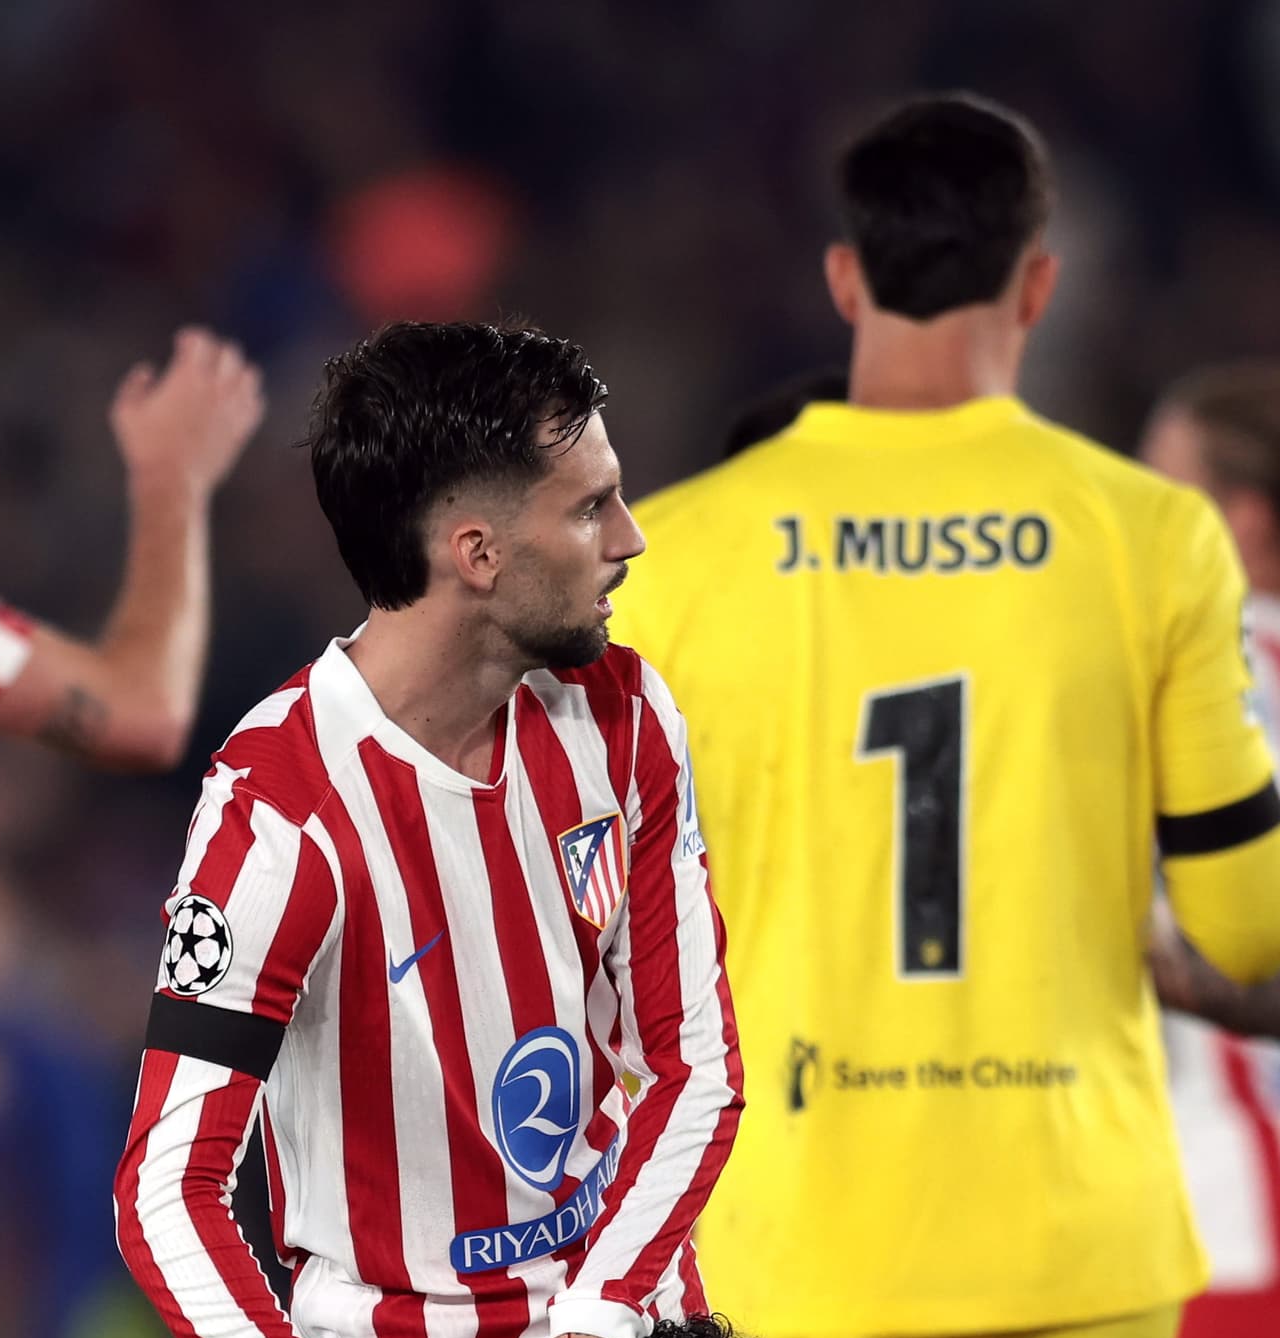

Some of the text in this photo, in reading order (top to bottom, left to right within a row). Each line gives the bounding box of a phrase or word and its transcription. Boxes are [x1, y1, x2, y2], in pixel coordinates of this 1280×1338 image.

[775, 513, 1053, 574] J. MUSSO
[856, 672, 968, 979] 1
[833, 1058, 907, 1089] Save
[918, 1057, 964, 1088] the
[463, 1183, 594, 1268] RIYADH
